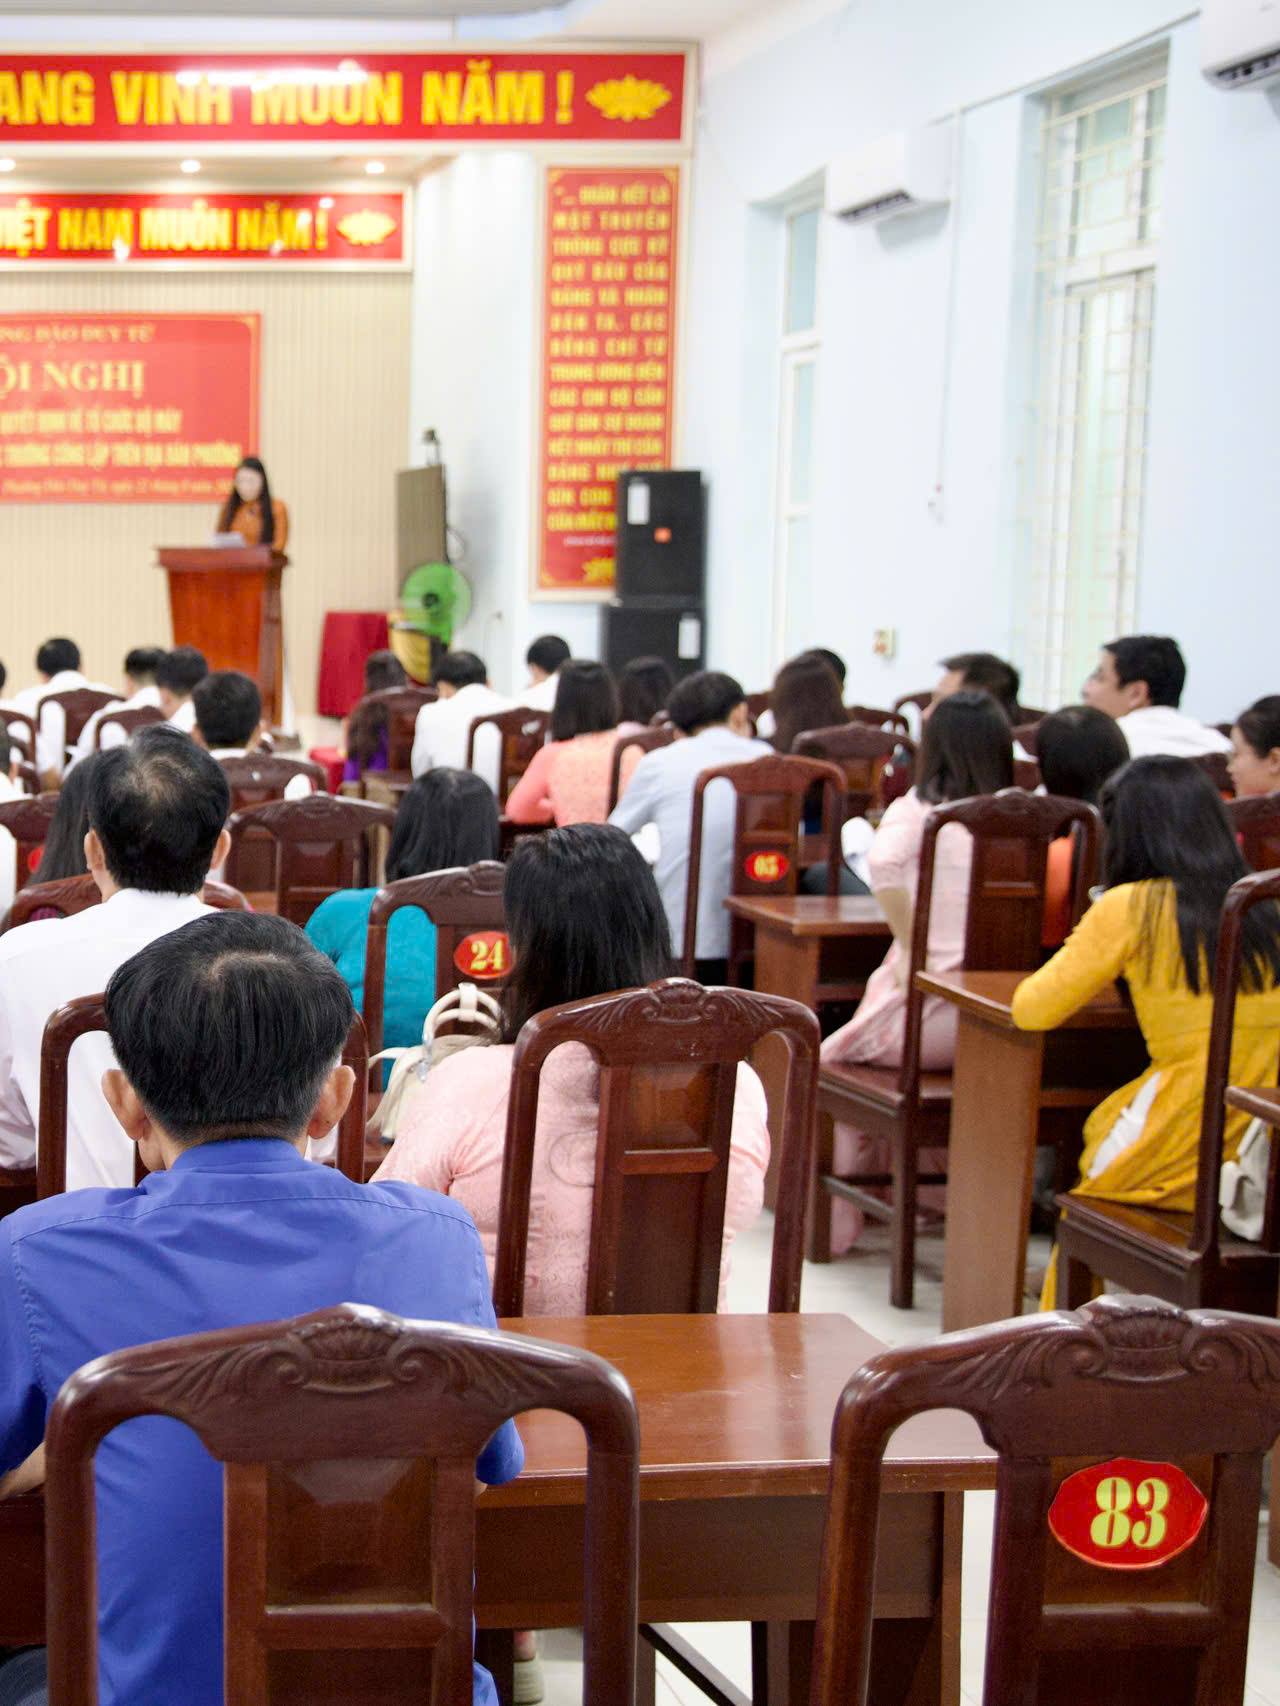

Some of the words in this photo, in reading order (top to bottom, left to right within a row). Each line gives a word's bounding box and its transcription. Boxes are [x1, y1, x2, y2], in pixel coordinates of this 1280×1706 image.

[109, 70, 233, 126] VINH
[250, 58, 403, 126] MUÔN
[422, 58, 544, 126] NĂM
[57, 207, 134, 250] NAM
[139, 198, 233, 250] MUÔN
[42, 360, 145, 399] NGHỊ
[470, 939, 503, 971] 24
[1090, 1477, 1169, 1549] 83
